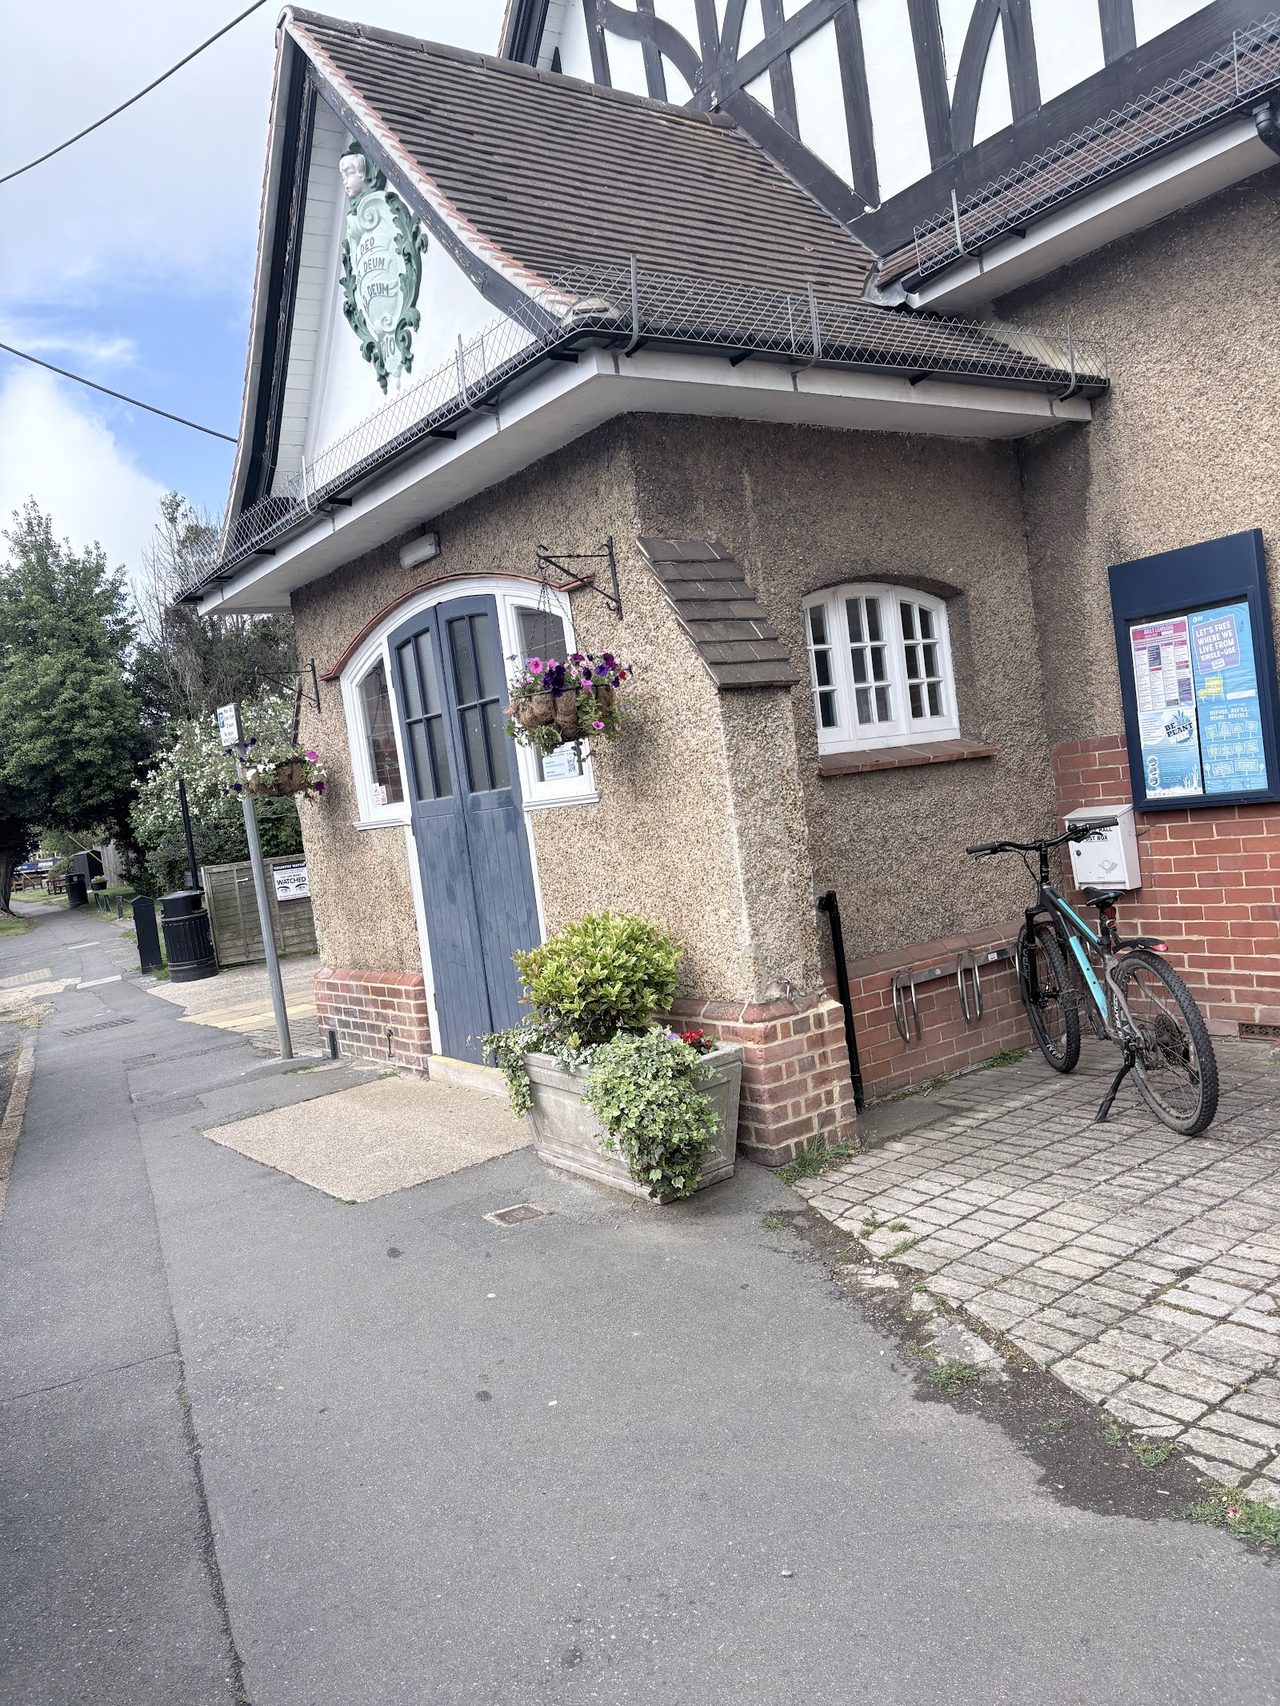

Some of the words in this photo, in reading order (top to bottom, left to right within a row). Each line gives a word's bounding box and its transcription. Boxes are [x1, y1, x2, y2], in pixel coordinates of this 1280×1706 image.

[363, 257, 385, 272] DEUM
[367, 283, 389, 297] DEUM
[1196, 626, 1214, 638] LET'S
[1215, 620, 1232, 631] FREE
[1197, 632, 1221, 646] WHERE
[1221, 630, 1233, 638] WE
[1199, 644, 1214, 654] LIVE
[1214, 638, 1235, 649] FROM
[1200, 647, 1236, 661] SINGLE-USE
[1164, 722, 1176, 731] BE
[1166, 723, 1193, 738] PLANT
[276, 876, 306, 885] WATCHED
